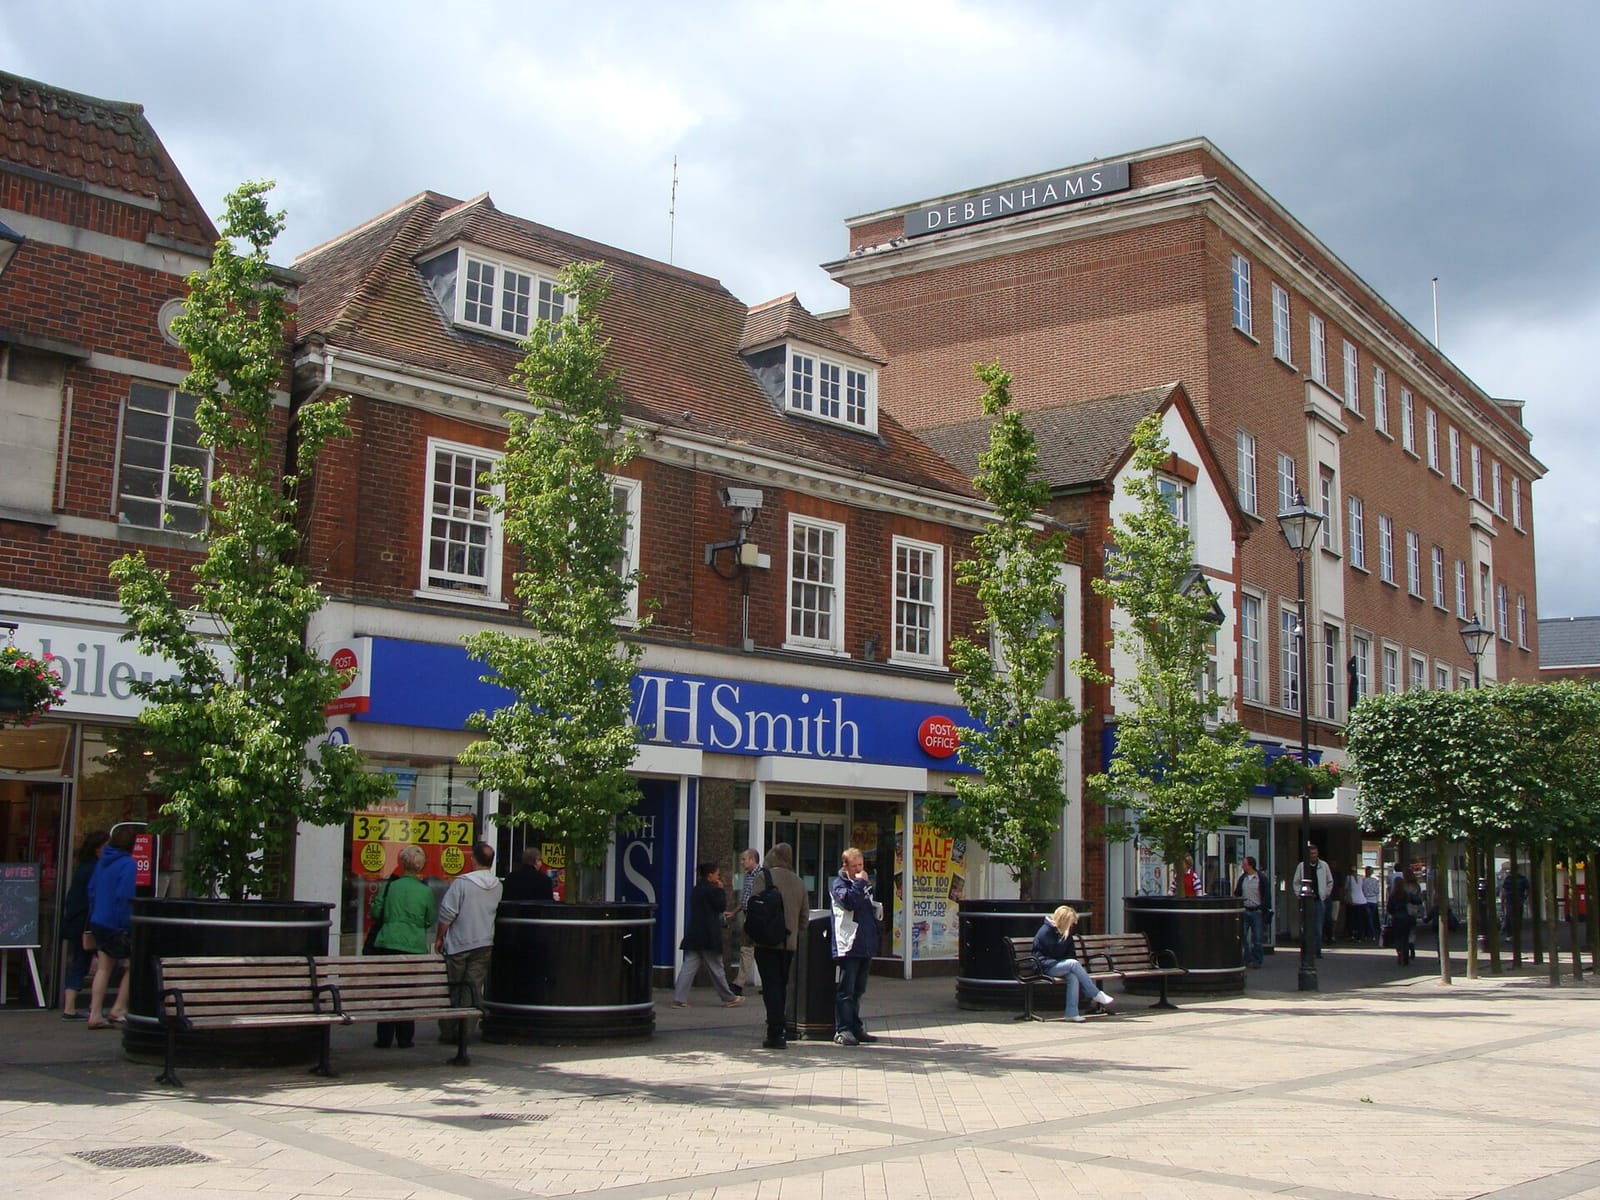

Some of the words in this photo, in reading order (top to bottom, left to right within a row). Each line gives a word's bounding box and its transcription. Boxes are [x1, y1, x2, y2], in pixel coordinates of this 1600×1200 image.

[926, 171, 1103, 229] DEBENHAMS
[335, 656, 352, 667] POST
[38, 638, 137, 701] bile
[929, 722, 951, 736] POST
[925, 736, 954, 749] OFFICE
[358, 817, 369, 839] 3
[378, 819, 390, 840] 2
[398, 820, 410, 841] 3
[418, 821, 430, 842] 2
[438, 822, 449, 843] 3
[457, 823, 468, 844] 2
[913, 823, 925, 834] UY
[366, 844, 380, 853] ALL
[446, 848, 459, 857] ALL
[545, 846, 566, 856] HAL
[913, 838, 952, 858] HALF
[547, 856, 566, 865] PRIC
[915, 859, 946, 873] PRICE
[912, 875, 933, 886] HOT
[935, 876, 949, 887] 100
[914, 901, 931, 909] HOT
[934, 902, 947, 910] 100
[914, 909, 945, 917] AUTHORS
